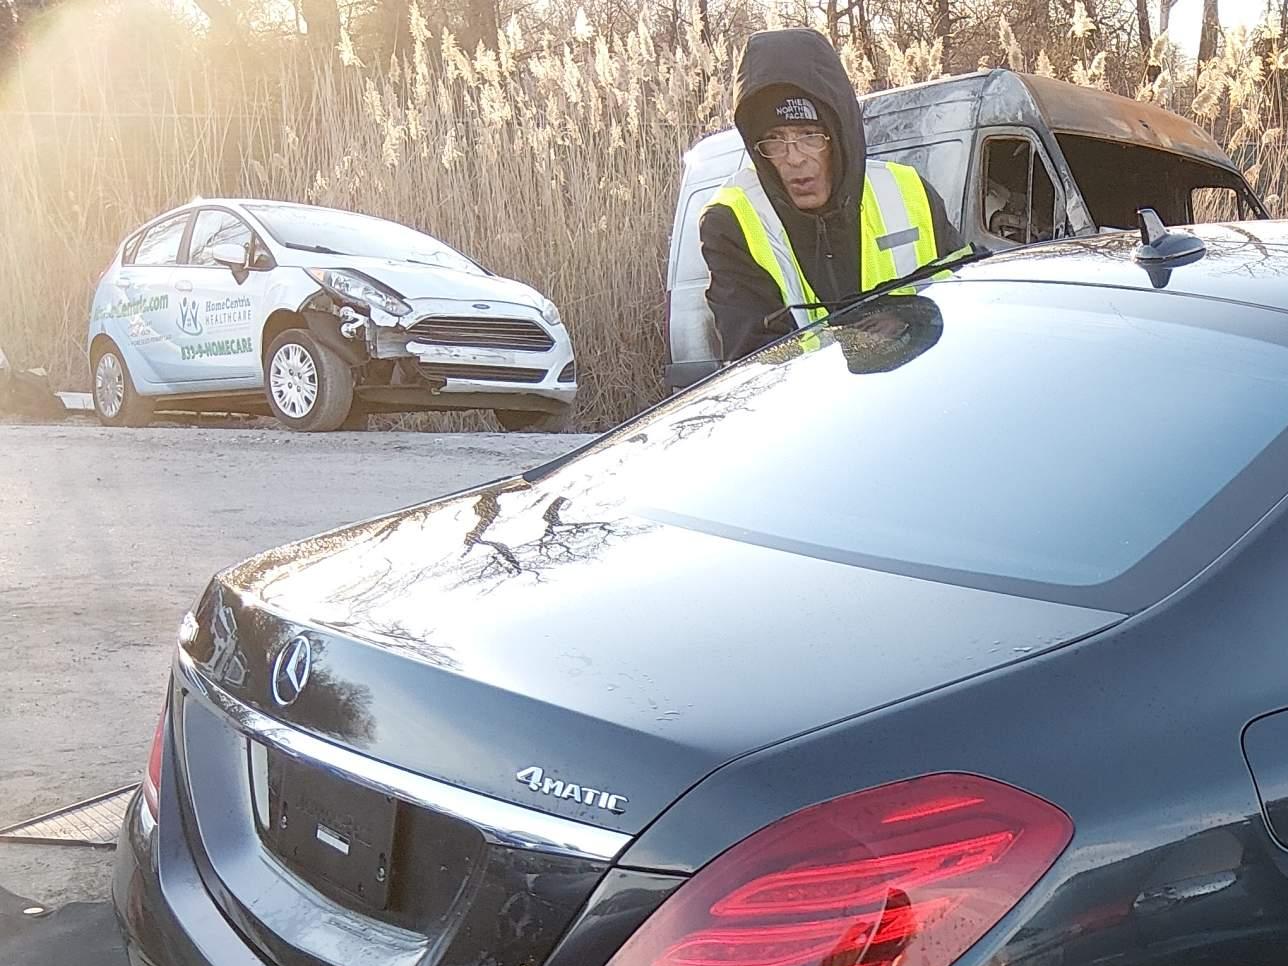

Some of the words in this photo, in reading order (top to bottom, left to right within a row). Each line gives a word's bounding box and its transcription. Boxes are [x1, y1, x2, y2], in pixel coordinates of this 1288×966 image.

[785, 98, 804, 106] THE
[775, 105, 804, 115] NORTH
[785, 112, 805, 120] FACE
[205, 297, 251, 312] HomeCentris
[205, 310, 252, 326] HEALTHCARE
[516, 766, 630, 814] 4MATIC
